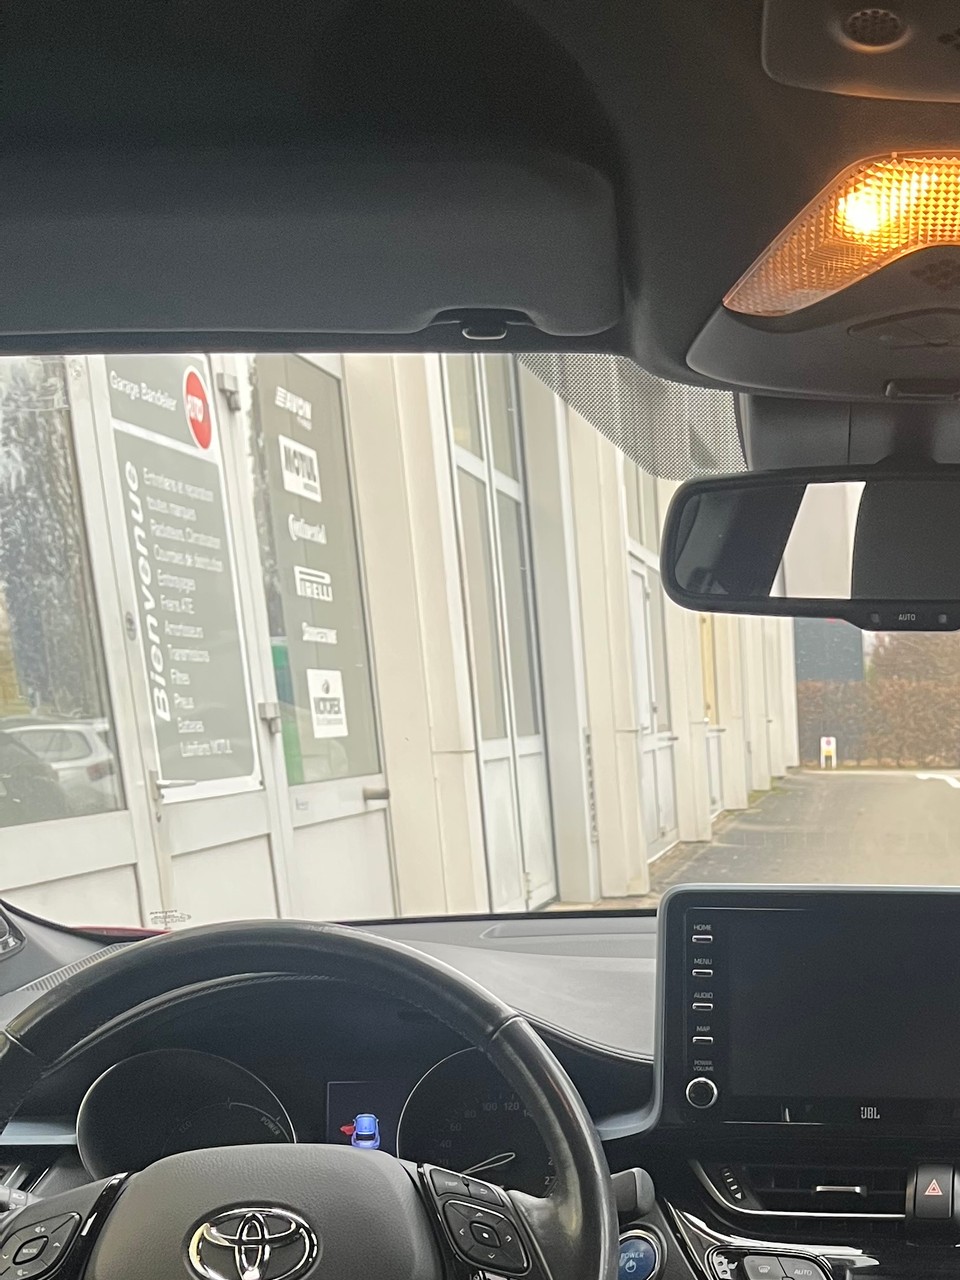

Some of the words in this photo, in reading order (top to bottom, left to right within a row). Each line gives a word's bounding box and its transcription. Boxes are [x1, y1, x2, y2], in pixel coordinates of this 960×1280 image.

[109, 370, 140, 400] Garage
[283, 446, 317, 482] MOTUL
[288, 513, 327, 545] Continental
[125, 461, 171, 722] Bienvenue
[293, 565, 334, 602] PIRELLI
[898, 613, 916, 621] AUTO
[504, 1102, 519, 1111] 120
[860, 1106, 881, 1119] JBL
[260, 1116, 281, 1136] POWER
[620, 1250, 645, 1259] POWER
[793, 1268, 813, 1276] AUTO
